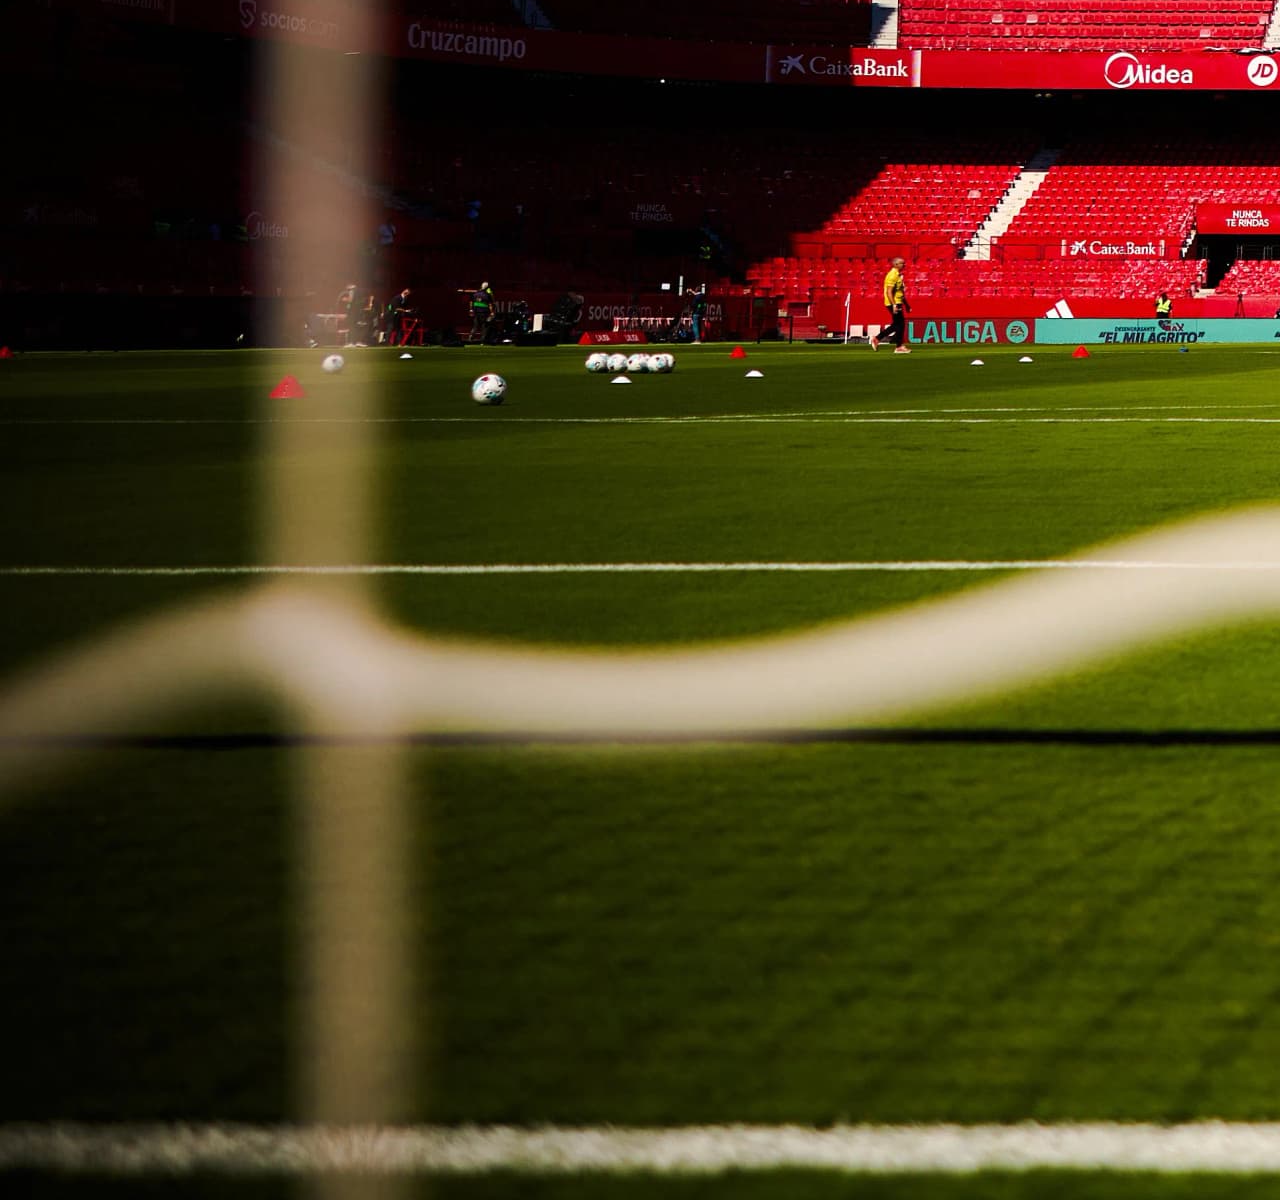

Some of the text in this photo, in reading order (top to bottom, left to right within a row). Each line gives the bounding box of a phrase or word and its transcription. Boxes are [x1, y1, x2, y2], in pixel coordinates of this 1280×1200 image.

[407, 23, 526, 61] Cruzcampo
[809, 55, 909, 78] CaixaBank
[1110, 58, 1194, 86] Midea
[1226, 218, 1237, 227] TE
[1232, 210, 1262, 219] NUNCA
[1090, 240, 1156, 256] CaixaBank
[907, 320, 998, 343] LALIGA
